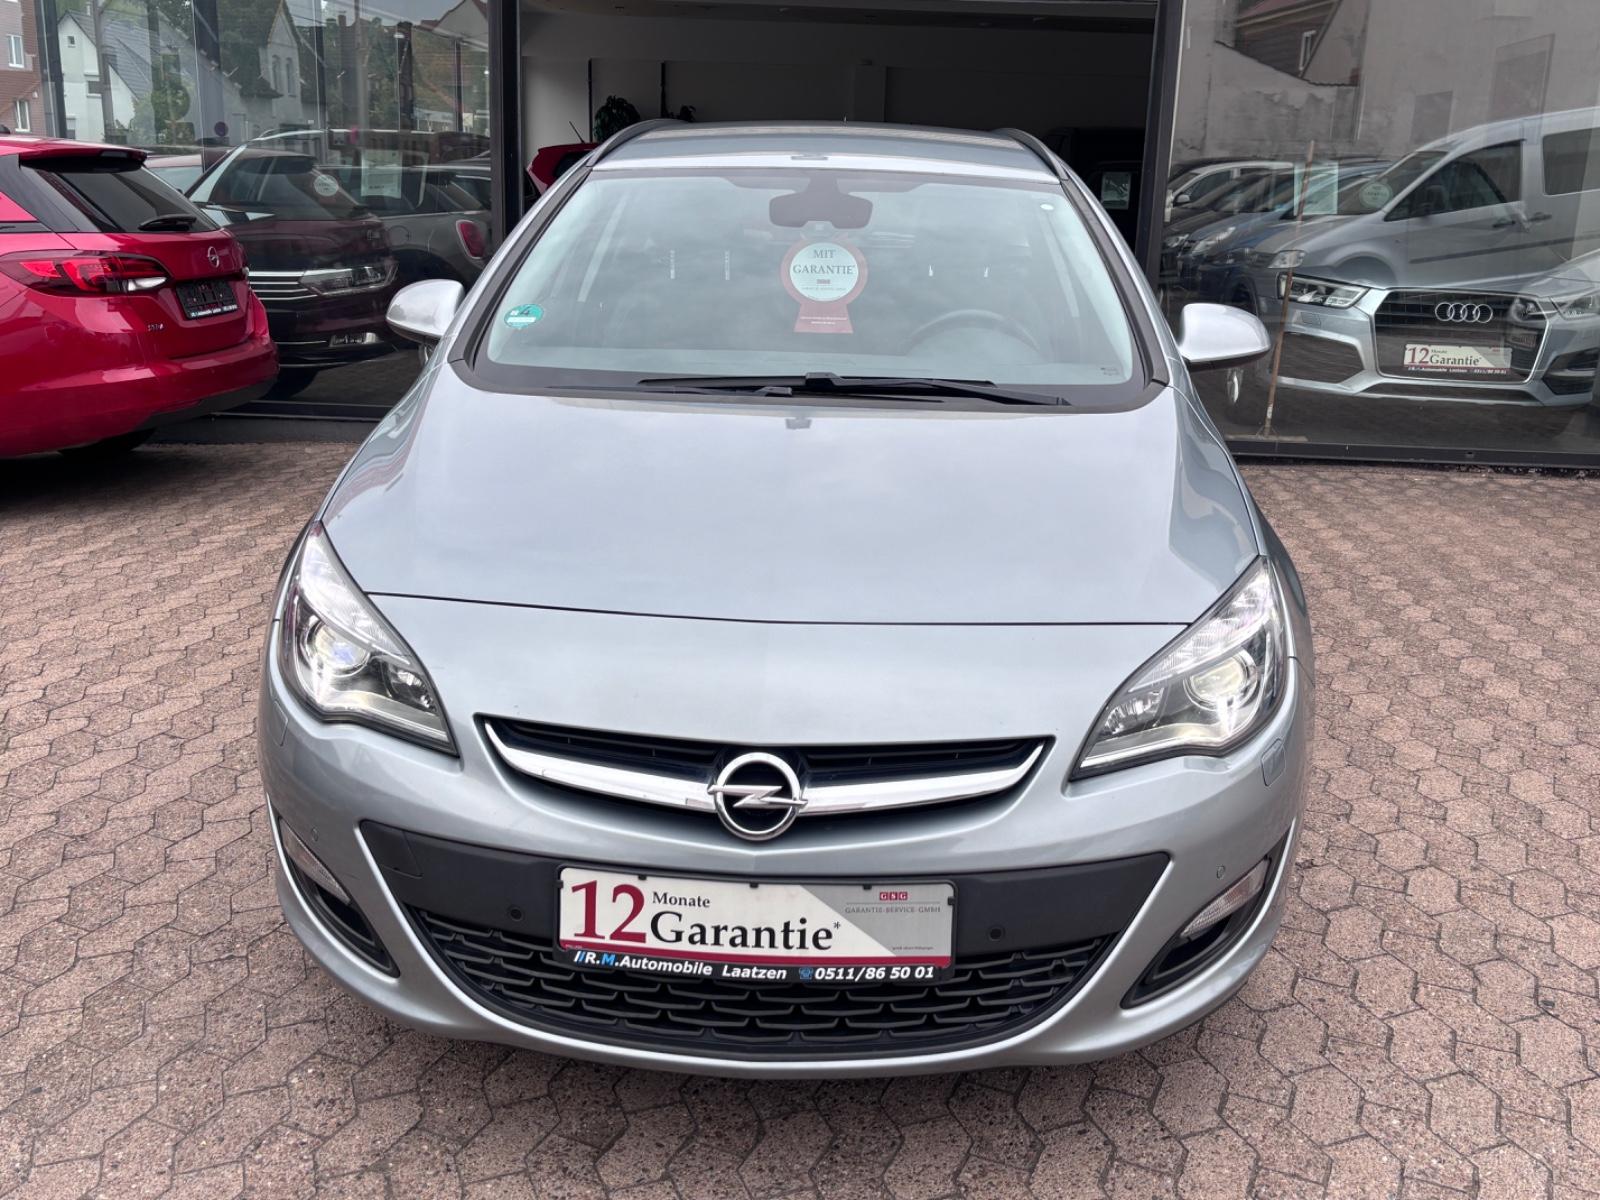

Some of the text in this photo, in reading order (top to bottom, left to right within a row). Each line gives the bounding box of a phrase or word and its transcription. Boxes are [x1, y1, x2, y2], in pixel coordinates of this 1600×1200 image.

[813, 249, 836, 259] MIT
[792, 264, 854, 275] GARANTIE
[1408, 346, 1429, 364] 12
[652, 891, 711, 908] Monate
[571, 879, 647, 944] 12
[722, 964, 787, 980] Laatzen
[815, 967, 886, 982] 0511/86
[889, 966, 911, 979] 50
[914, 966, 934, 979] 01
